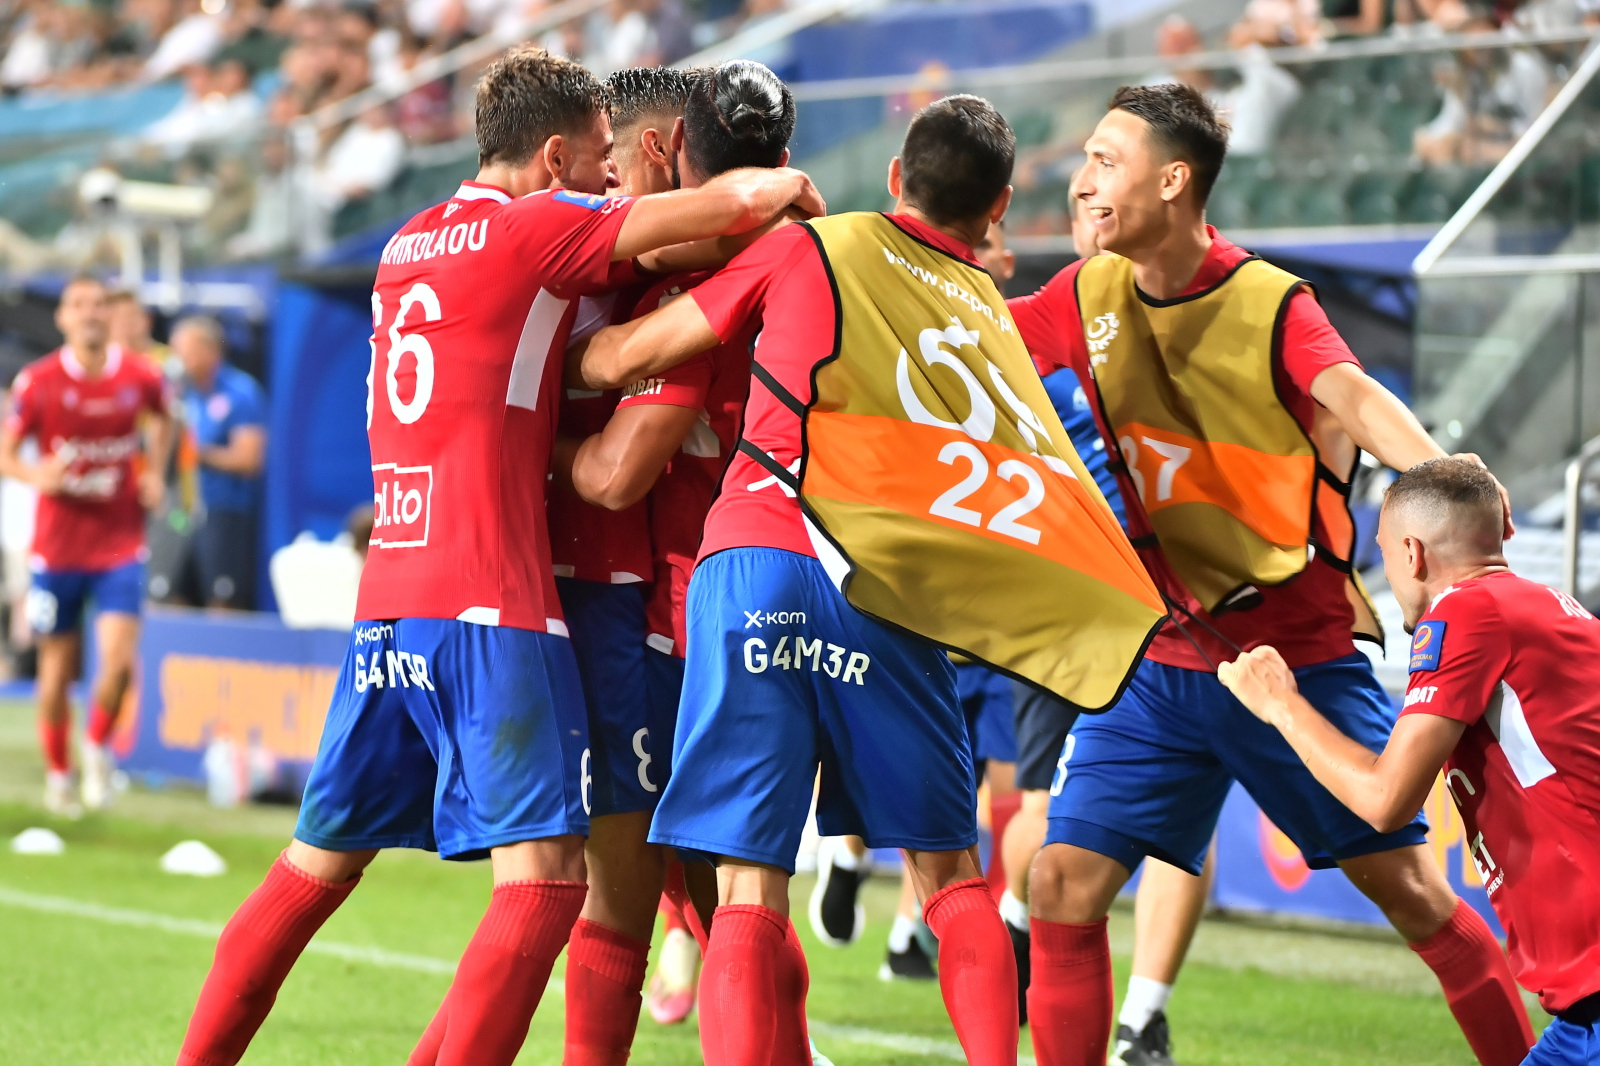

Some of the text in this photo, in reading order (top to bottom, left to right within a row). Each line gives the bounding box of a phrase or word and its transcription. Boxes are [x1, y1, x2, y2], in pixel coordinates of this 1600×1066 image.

[365, 282, 442, 431] 6
[928, 440, 1046, 546] 22
[743, 635, 871, 686] G4M3R
